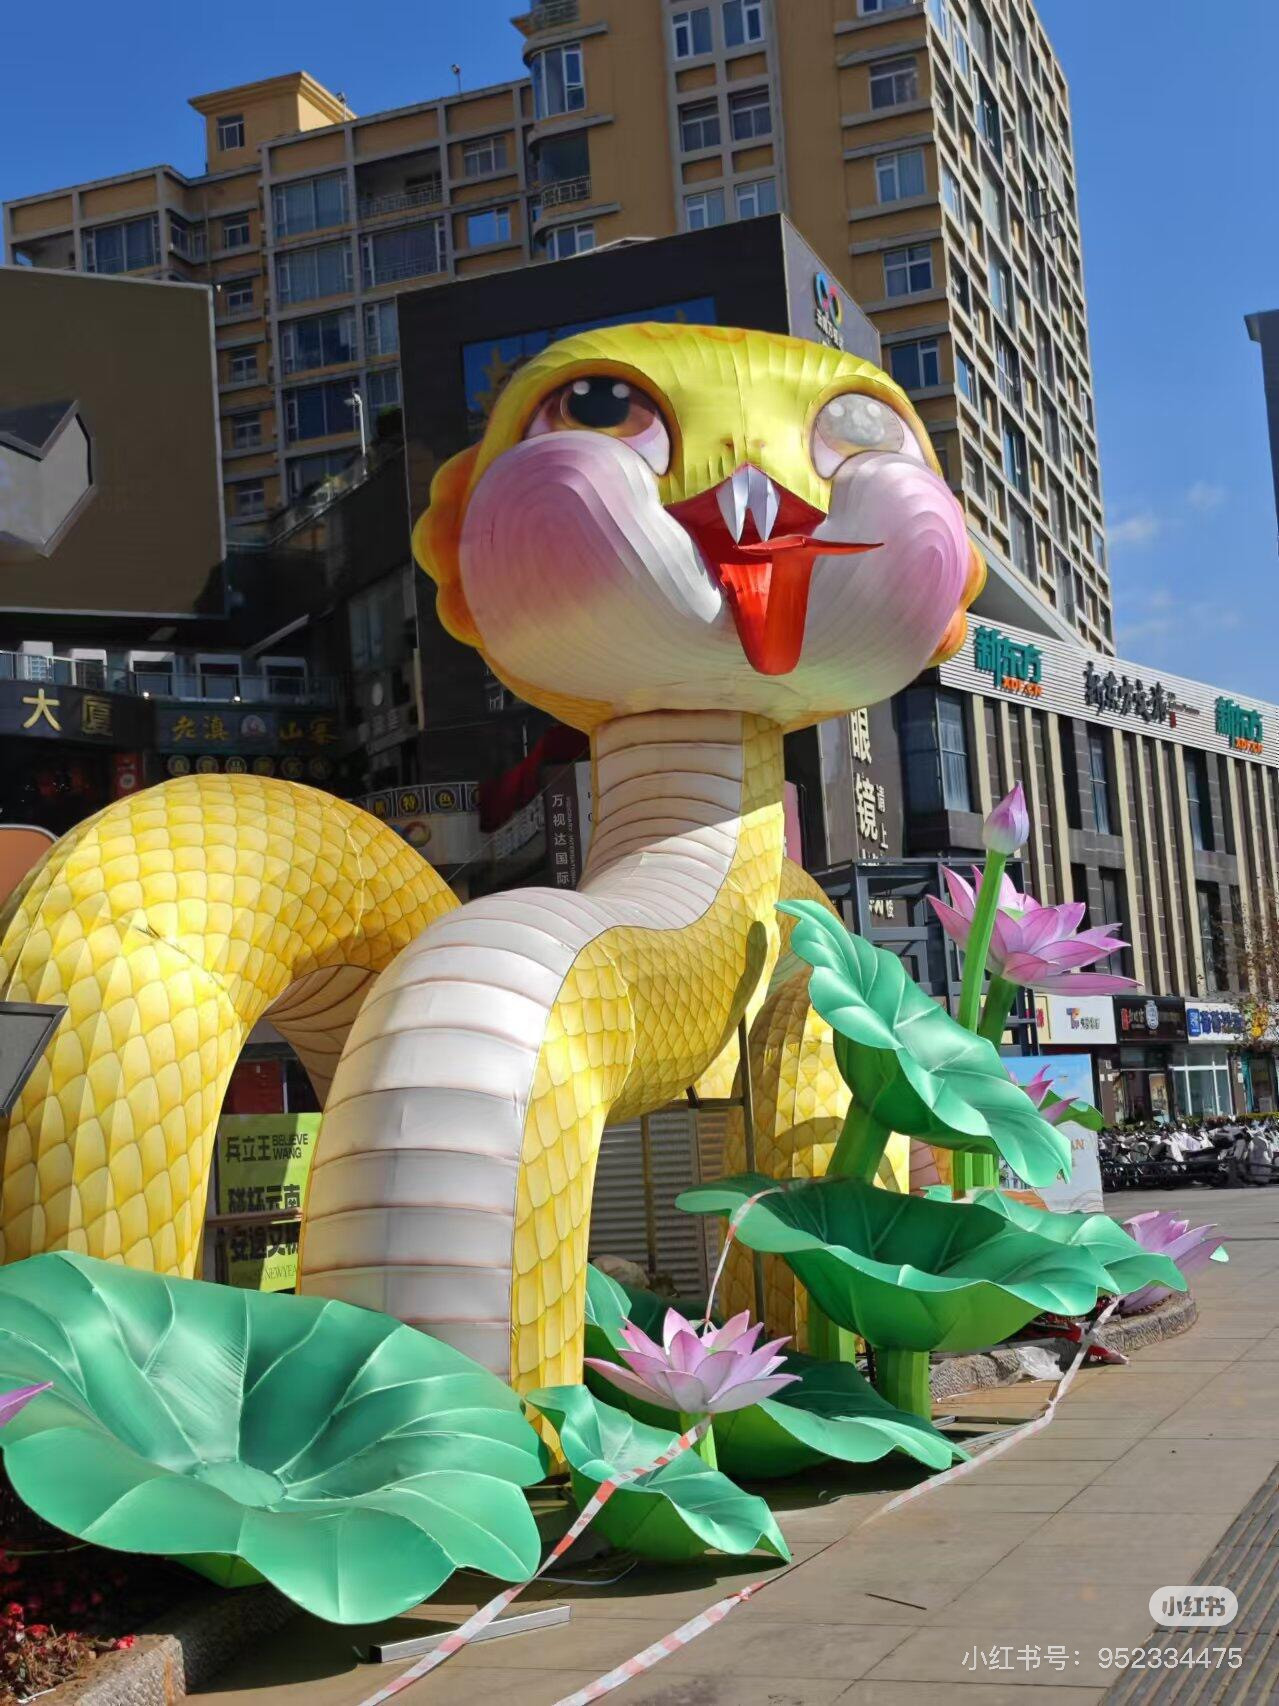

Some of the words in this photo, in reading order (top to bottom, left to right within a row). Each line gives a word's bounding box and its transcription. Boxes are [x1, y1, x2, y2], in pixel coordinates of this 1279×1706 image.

[975, 625, 1042, 688] 新东方
[22, 687, 113, 737] 大厦
[1215, 696, 1263, 749] 新东方
[552, 793, 570, 885] 万视达国际
[272, 1133, 309, 1148] BELIEVE
[273, 1146, 302, 1161] WANG
